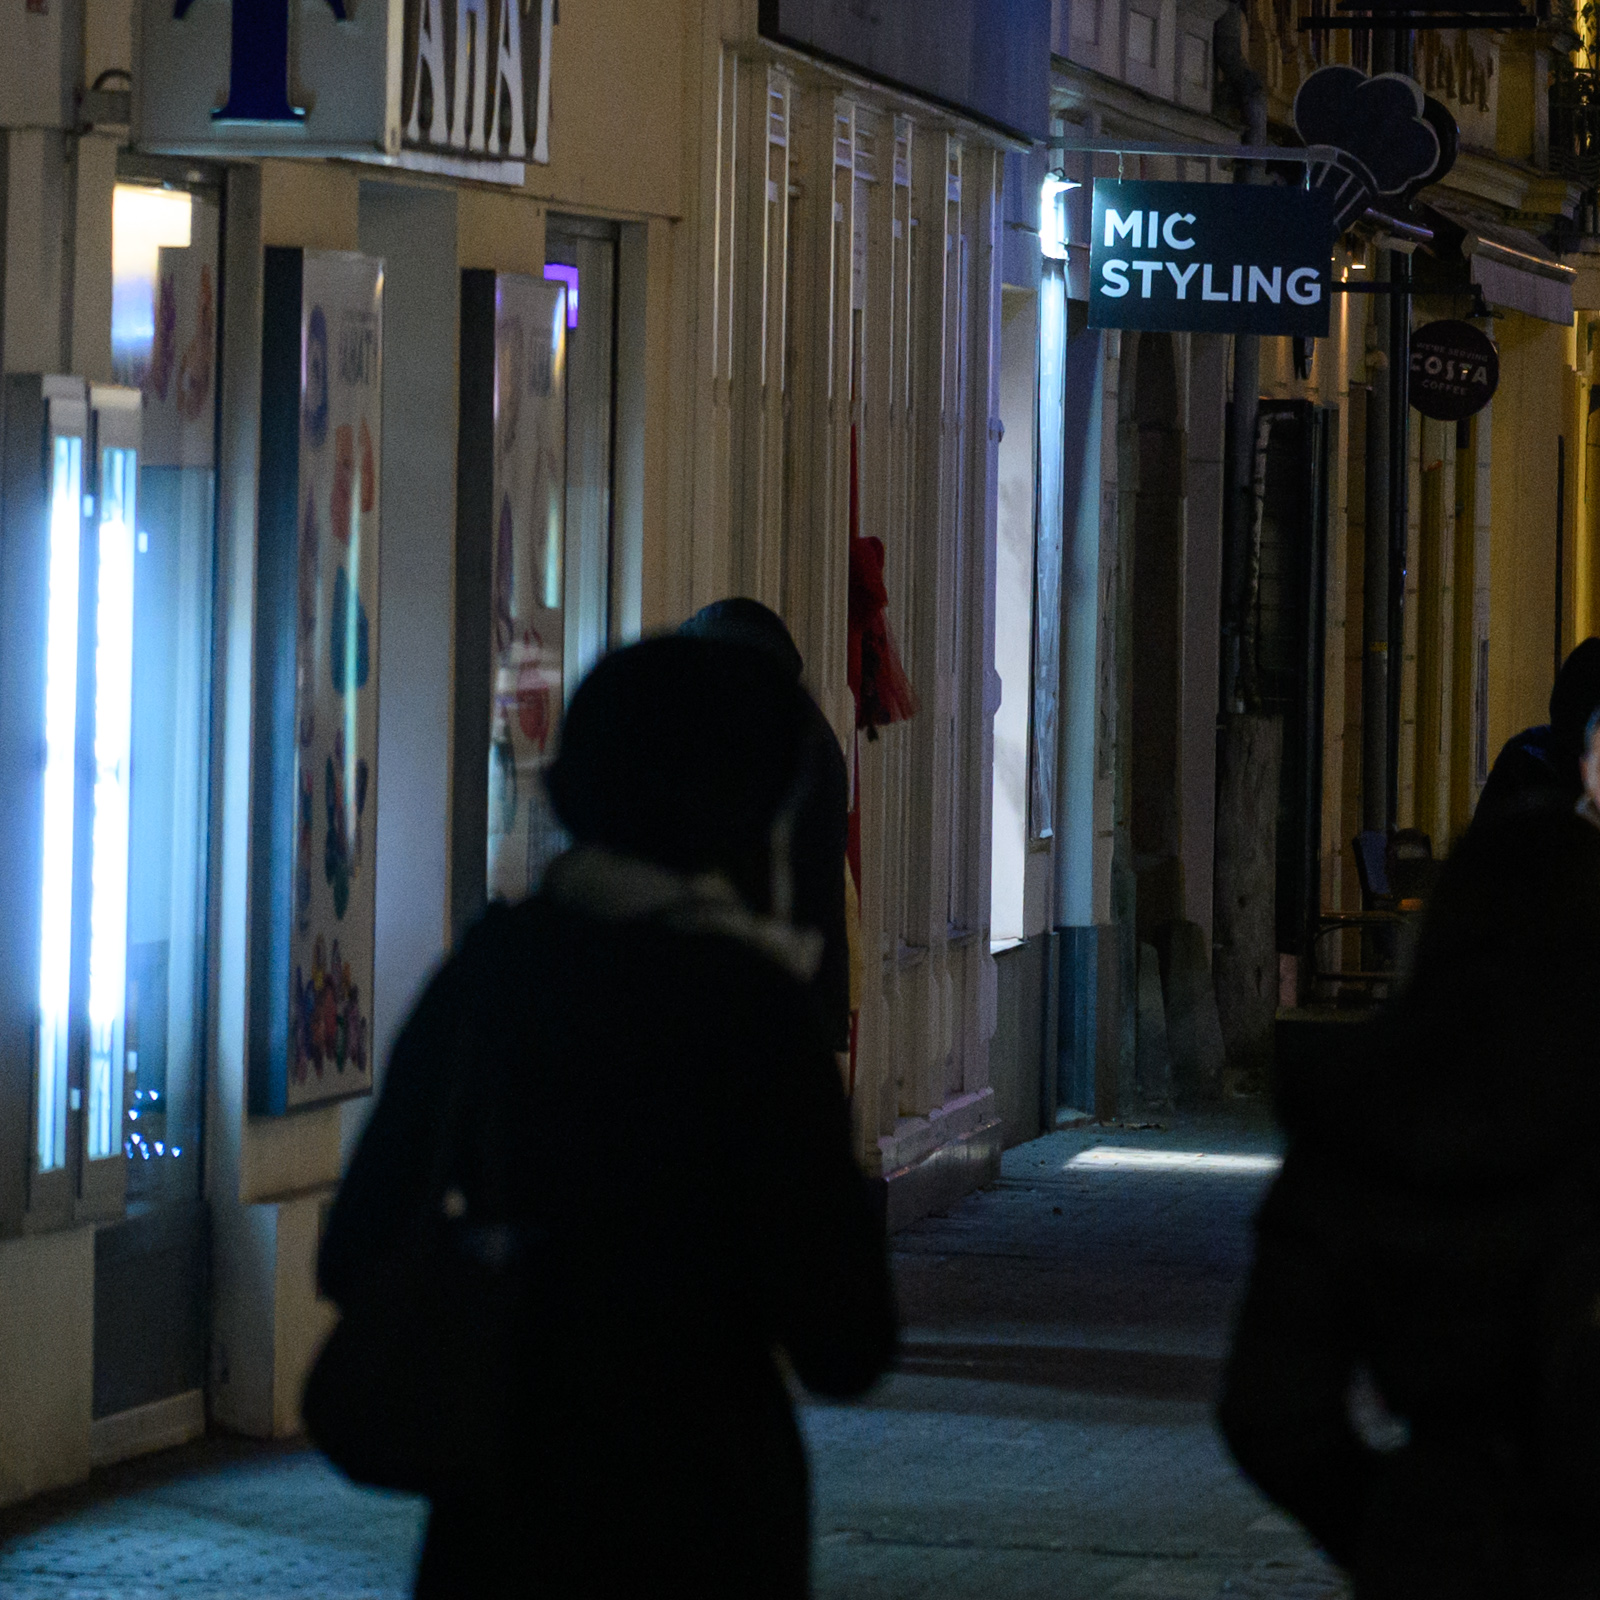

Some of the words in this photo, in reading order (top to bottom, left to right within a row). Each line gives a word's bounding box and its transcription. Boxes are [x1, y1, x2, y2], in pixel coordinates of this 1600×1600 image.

[1100, 258, 1322, 306] STYLING
[1410, 351, 1488, 386] COSTA
[1422, 379, 1468, 396] COFFEE
